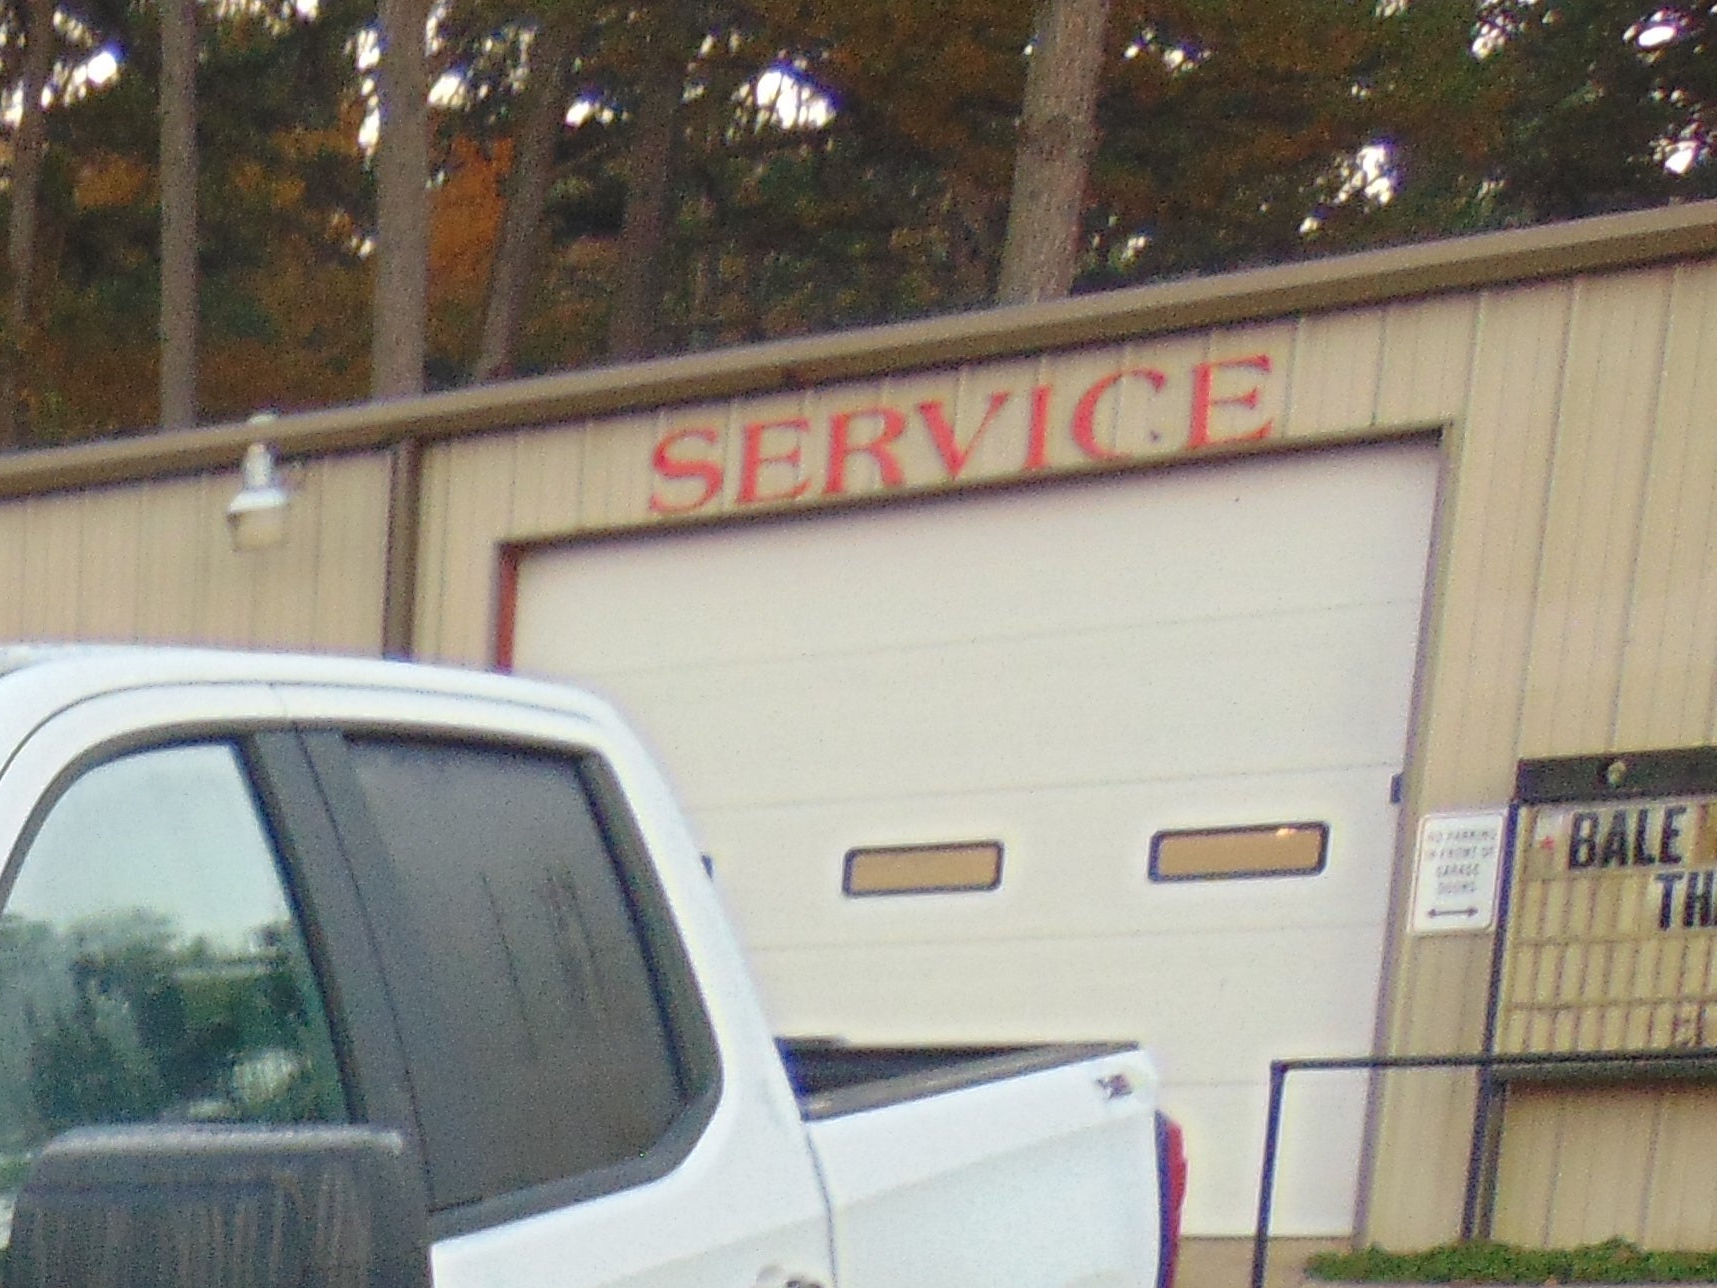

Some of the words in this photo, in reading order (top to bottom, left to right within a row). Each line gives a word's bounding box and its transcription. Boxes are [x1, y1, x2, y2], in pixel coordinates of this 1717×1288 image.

[648, 353, 1275, 514] SERVICE
[1568, 806, 1687, 869] BALE
[1654, 870, 1717, 932] TH
